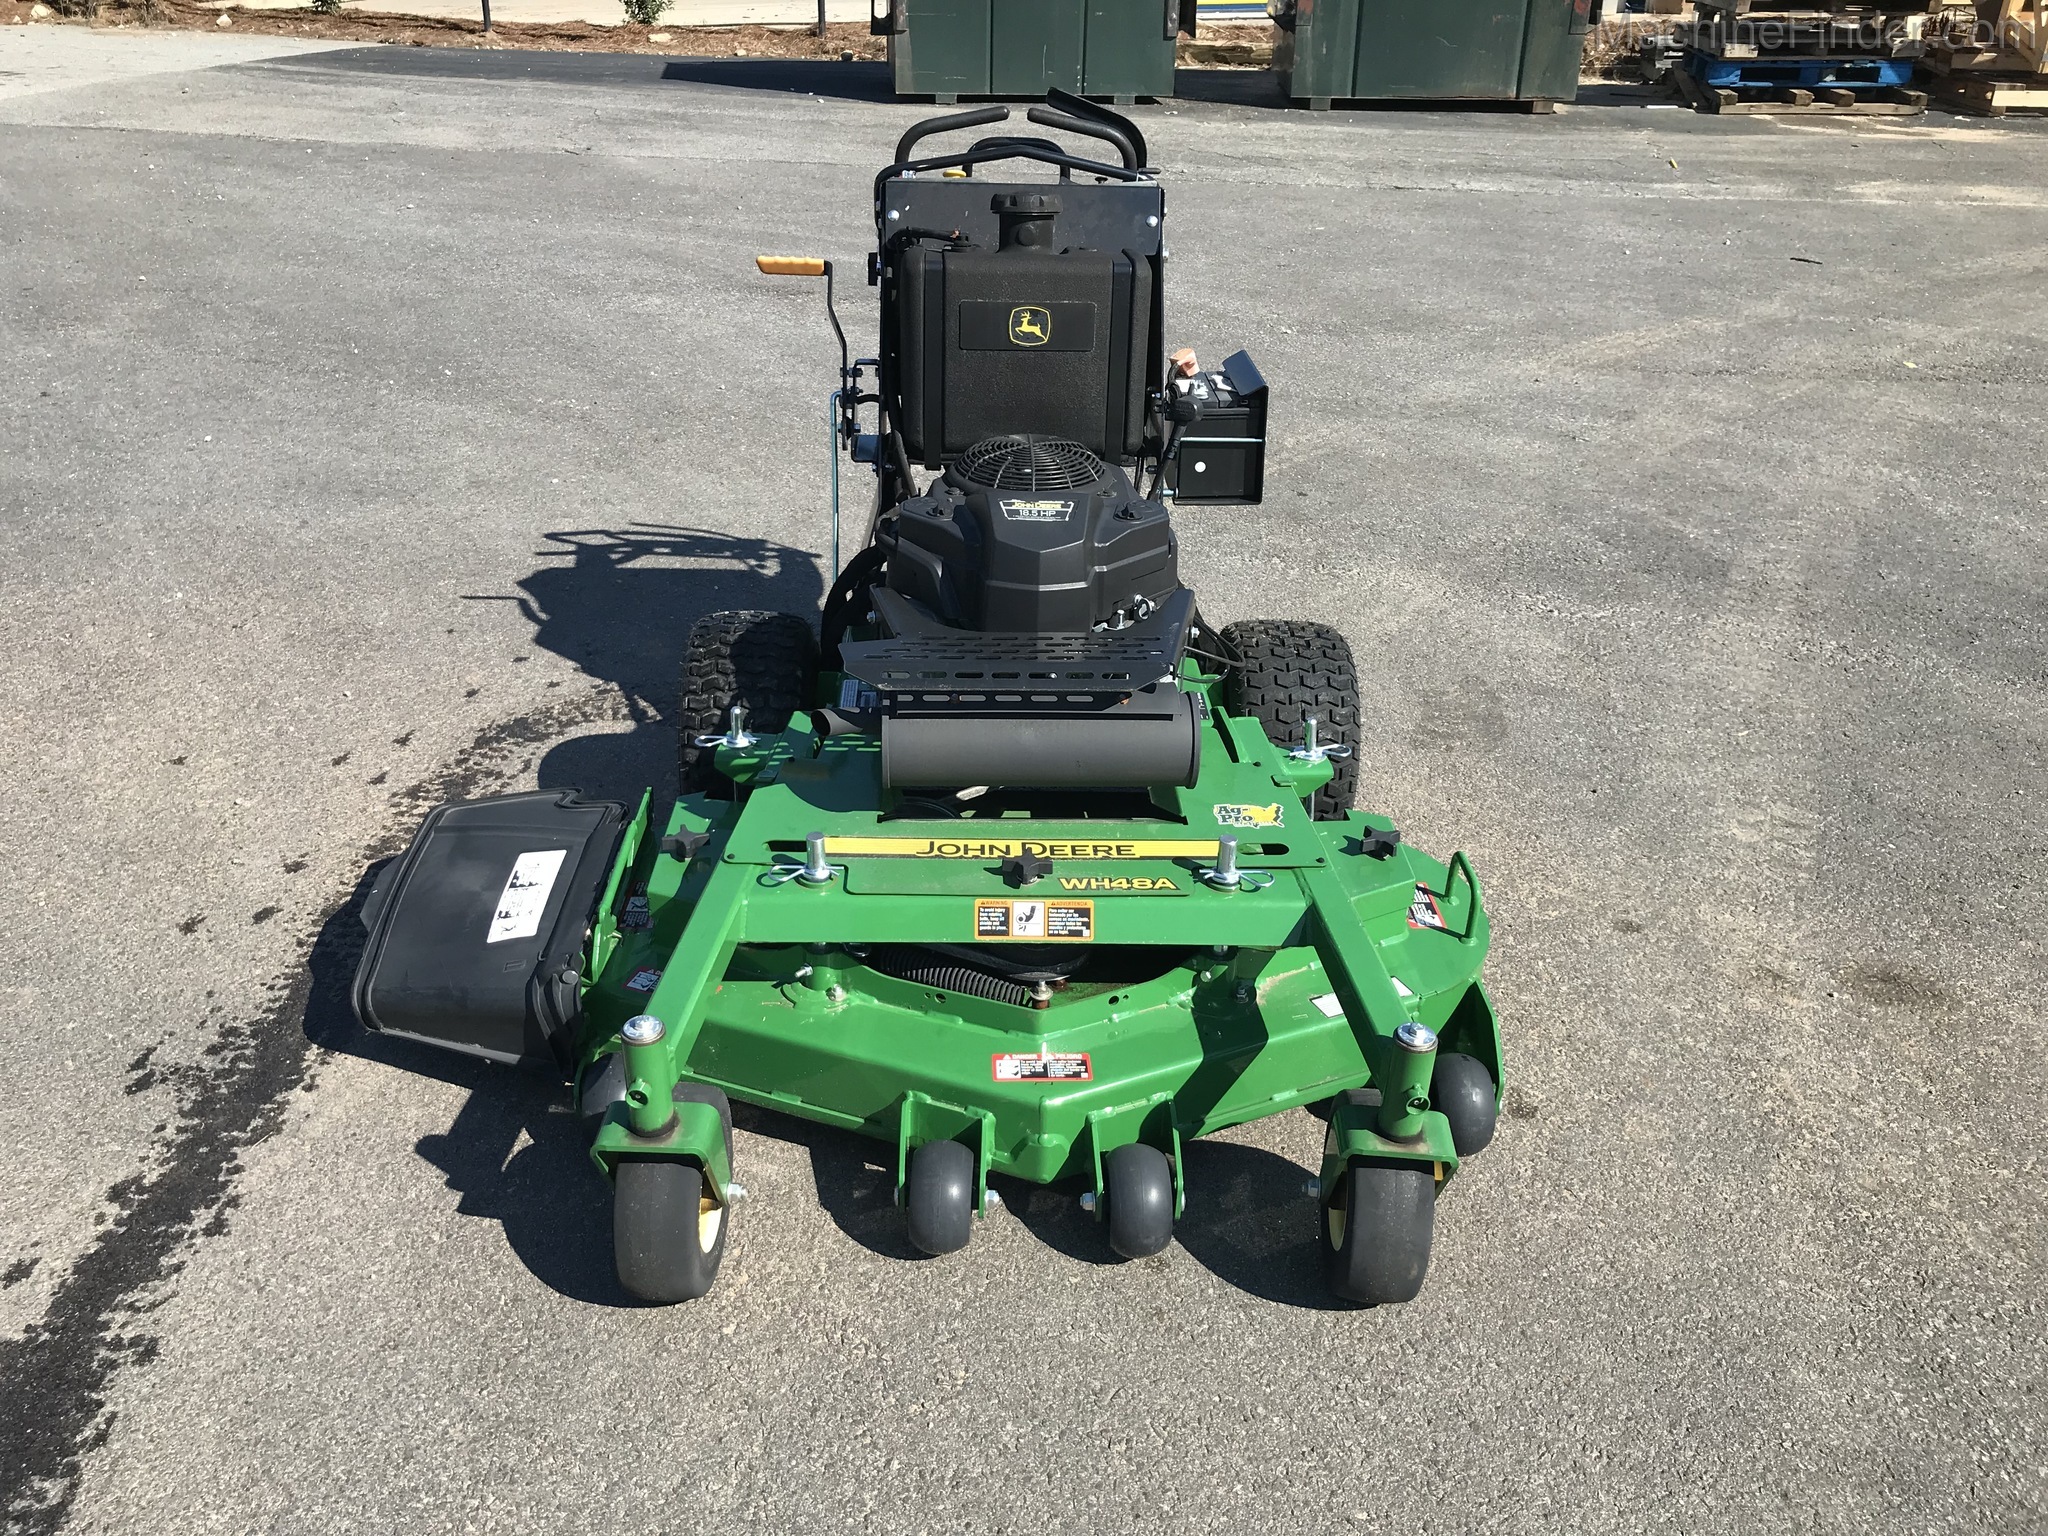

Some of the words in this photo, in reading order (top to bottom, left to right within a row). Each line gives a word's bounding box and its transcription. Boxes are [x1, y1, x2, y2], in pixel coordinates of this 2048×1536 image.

[1219, 814, 1253, 823] Pro
[916, 841, 1010, 856] JOHN
[1021, 841, 1135, 857] DEERE
[1060, 877, 1179, 890] WH48A
